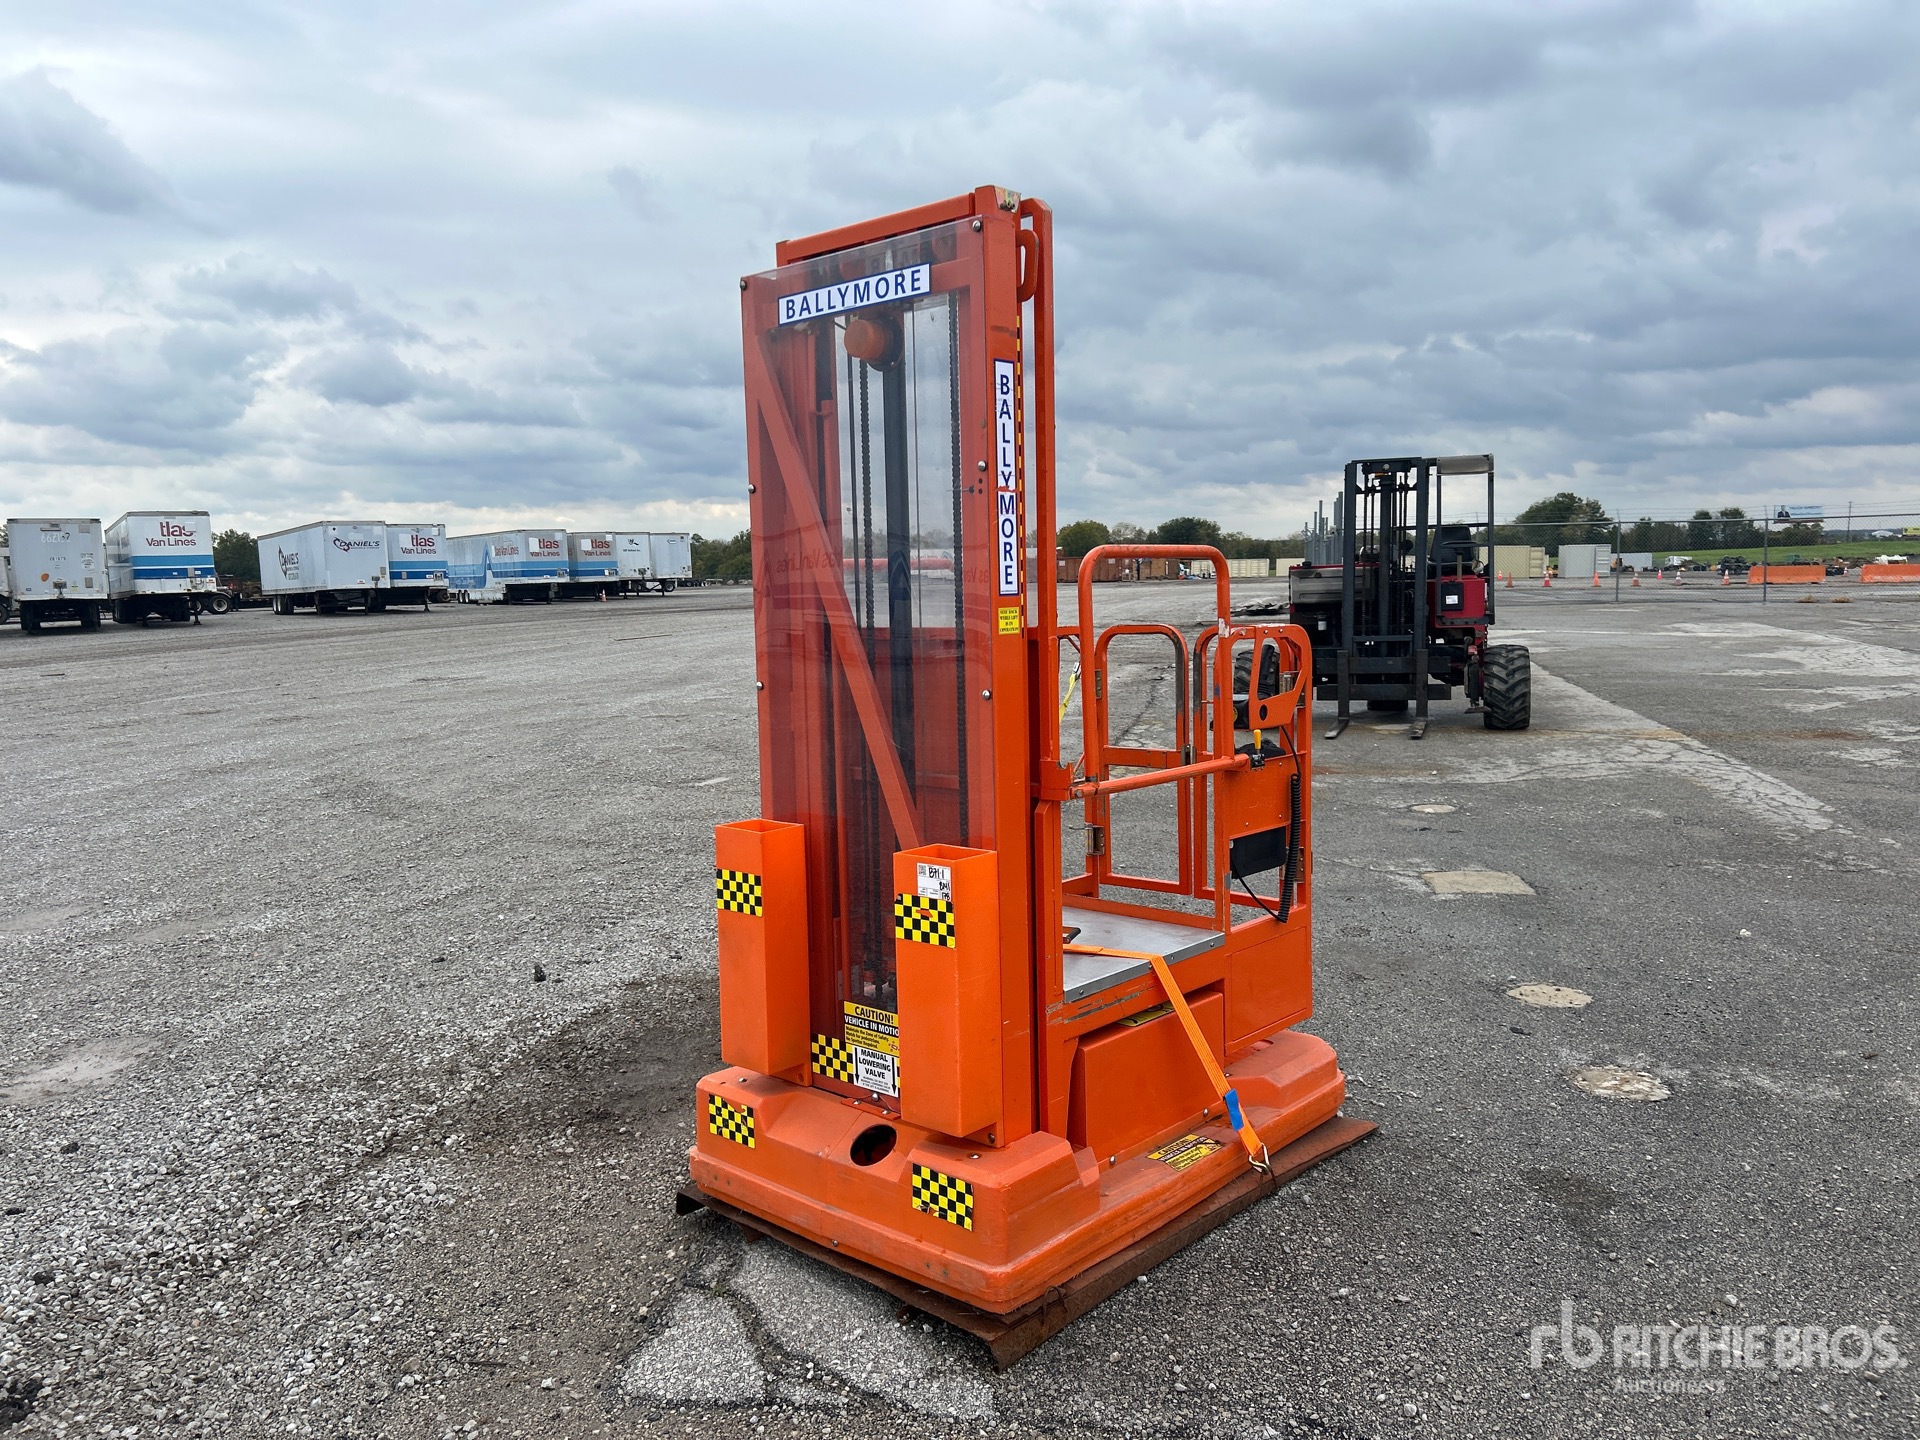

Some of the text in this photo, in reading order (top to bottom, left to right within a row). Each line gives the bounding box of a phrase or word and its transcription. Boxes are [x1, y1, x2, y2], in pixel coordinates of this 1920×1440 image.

[786, 269, 921, 319] BALLYMORE
[999, 374, 1015, 586] BALLYMORE
[145, 538, 197, 547] Van Lines
[411, 535, 435, 547] tlas
[854, 1006, 894, 1025] CAUTION!
[845, 1015, 899, 1036] VEHICLE IN MOTIO
[860, 1049, 888, 1062] MANUAL
[858, 1057, 891, 1072] LOWERING
[865, 1067, 886, 1079] VALVE
